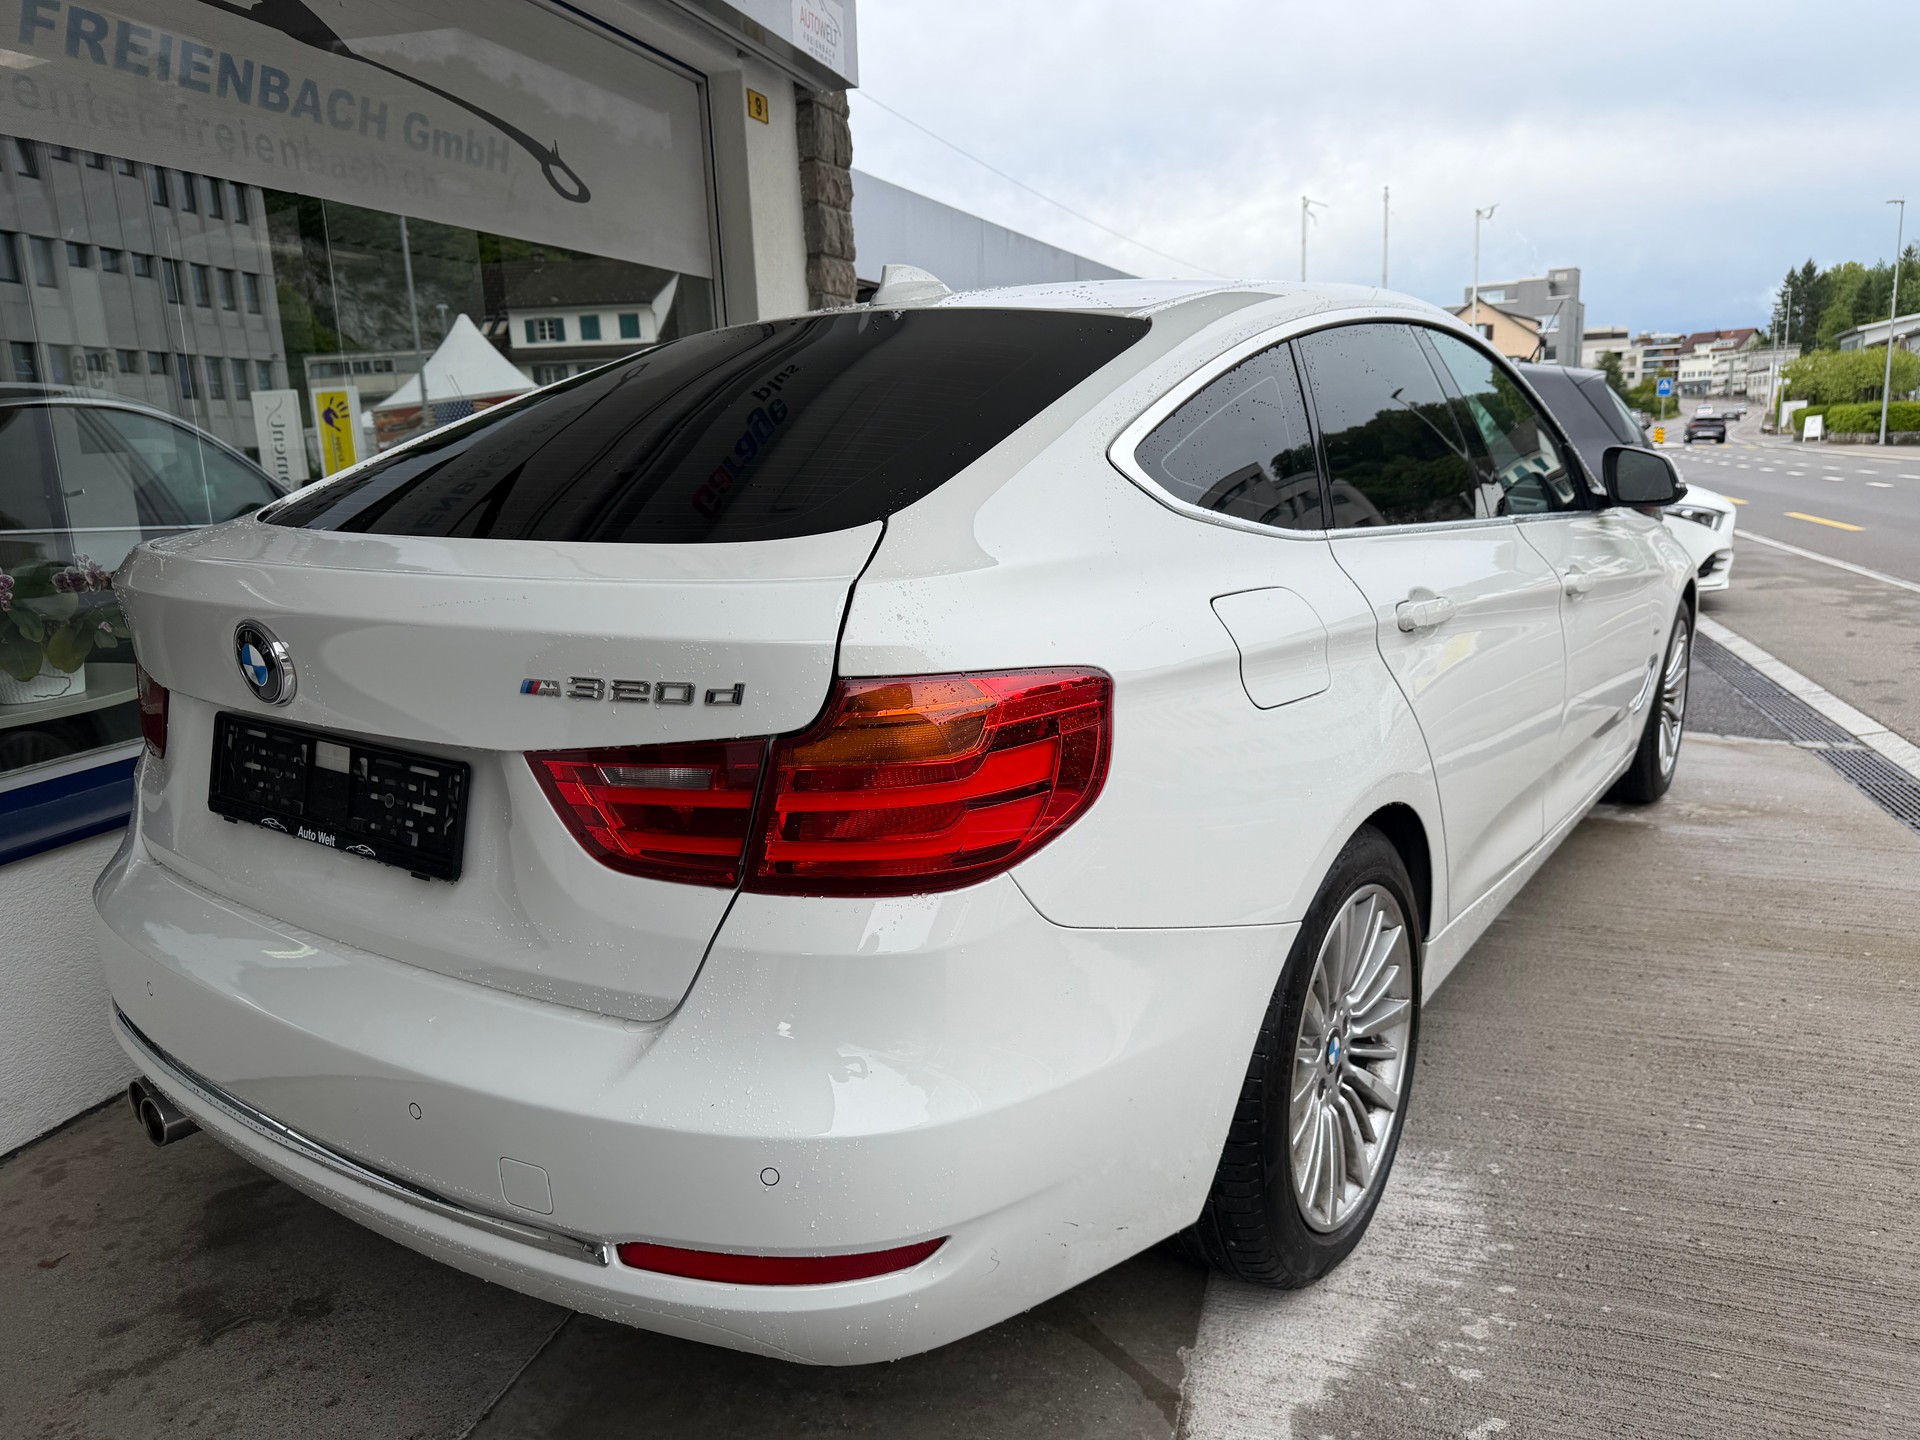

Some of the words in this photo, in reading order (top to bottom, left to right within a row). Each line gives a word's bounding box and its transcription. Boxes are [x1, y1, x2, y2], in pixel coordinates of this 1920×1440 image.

[800, 6, 838, 47] AUTOWELT
[803, 32, 836, 59] FREENBACH
[18, 0, 388, 141] FREIENBACH
[402, 111, 510, 175] GmbH
[755, 96, 762, 117] 9
[297, 825, 316, 841] Auto
[318, 830, 336, 847] Welt
